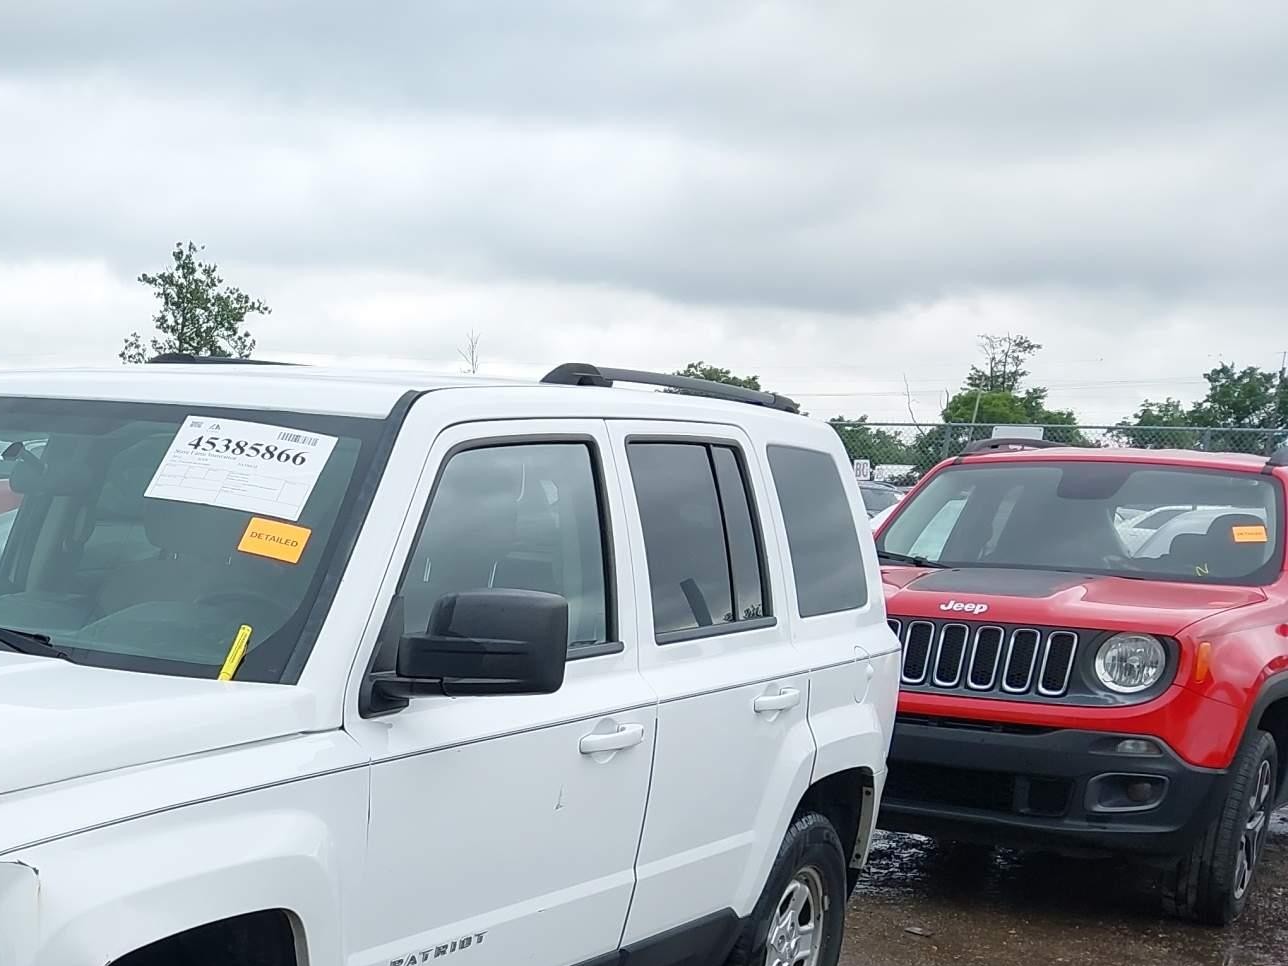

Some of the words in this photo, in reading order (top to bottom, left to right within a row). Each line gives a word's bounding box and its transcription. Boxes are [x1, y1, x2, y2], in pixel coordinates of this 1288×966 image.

[187, 435, 310, 466] 45385866
[249, 531, 300, 548] DETAILED
[940, 600, 988, 614] Jeep
